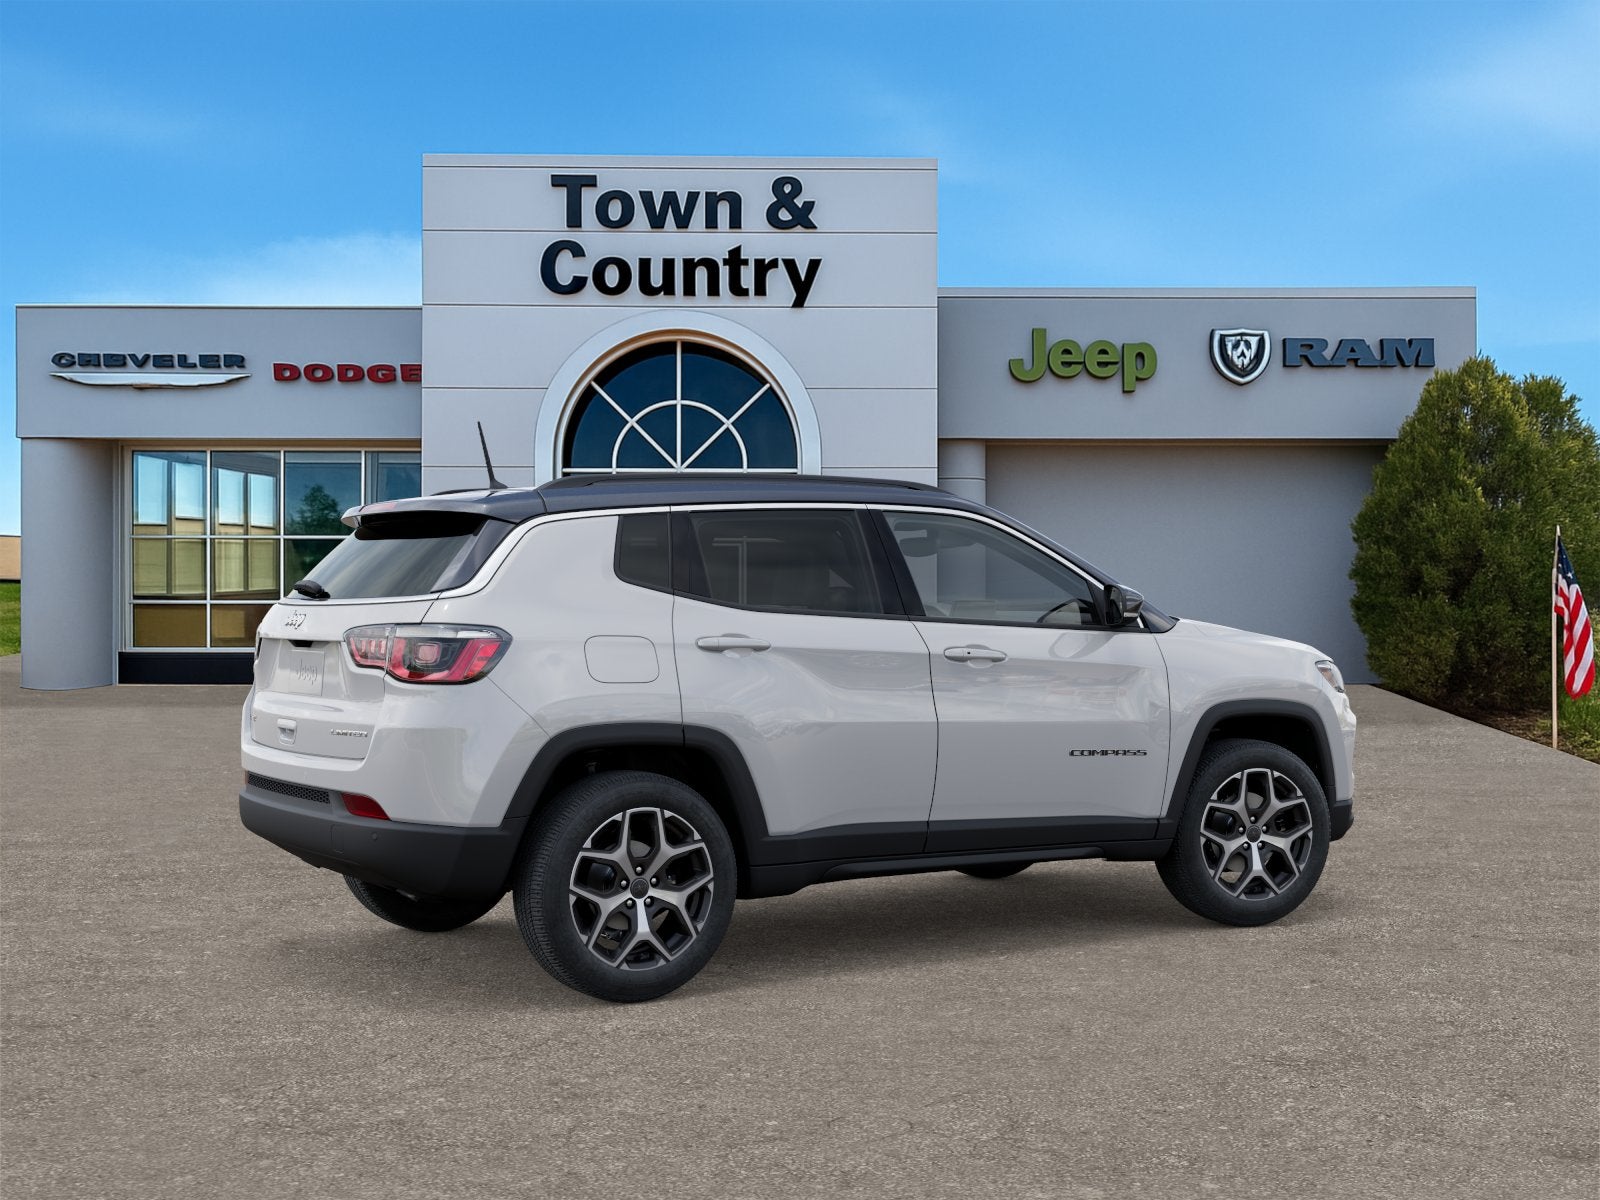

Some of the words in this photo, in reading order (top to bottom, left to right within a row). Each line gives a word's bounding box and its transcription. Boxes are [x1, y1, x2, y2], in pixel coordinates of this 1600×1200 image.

[550, 174, 743, 229] Town
[765, 175, 818, 230] &
[540, 239, 823, 308] Country
[273, 363, 422, 383] DODGE
[1009, 328, 1157, 393] Jeep
[1282, 337, 1436, 368] RAM
[1069, 749, 1148, 757] COMPASS
